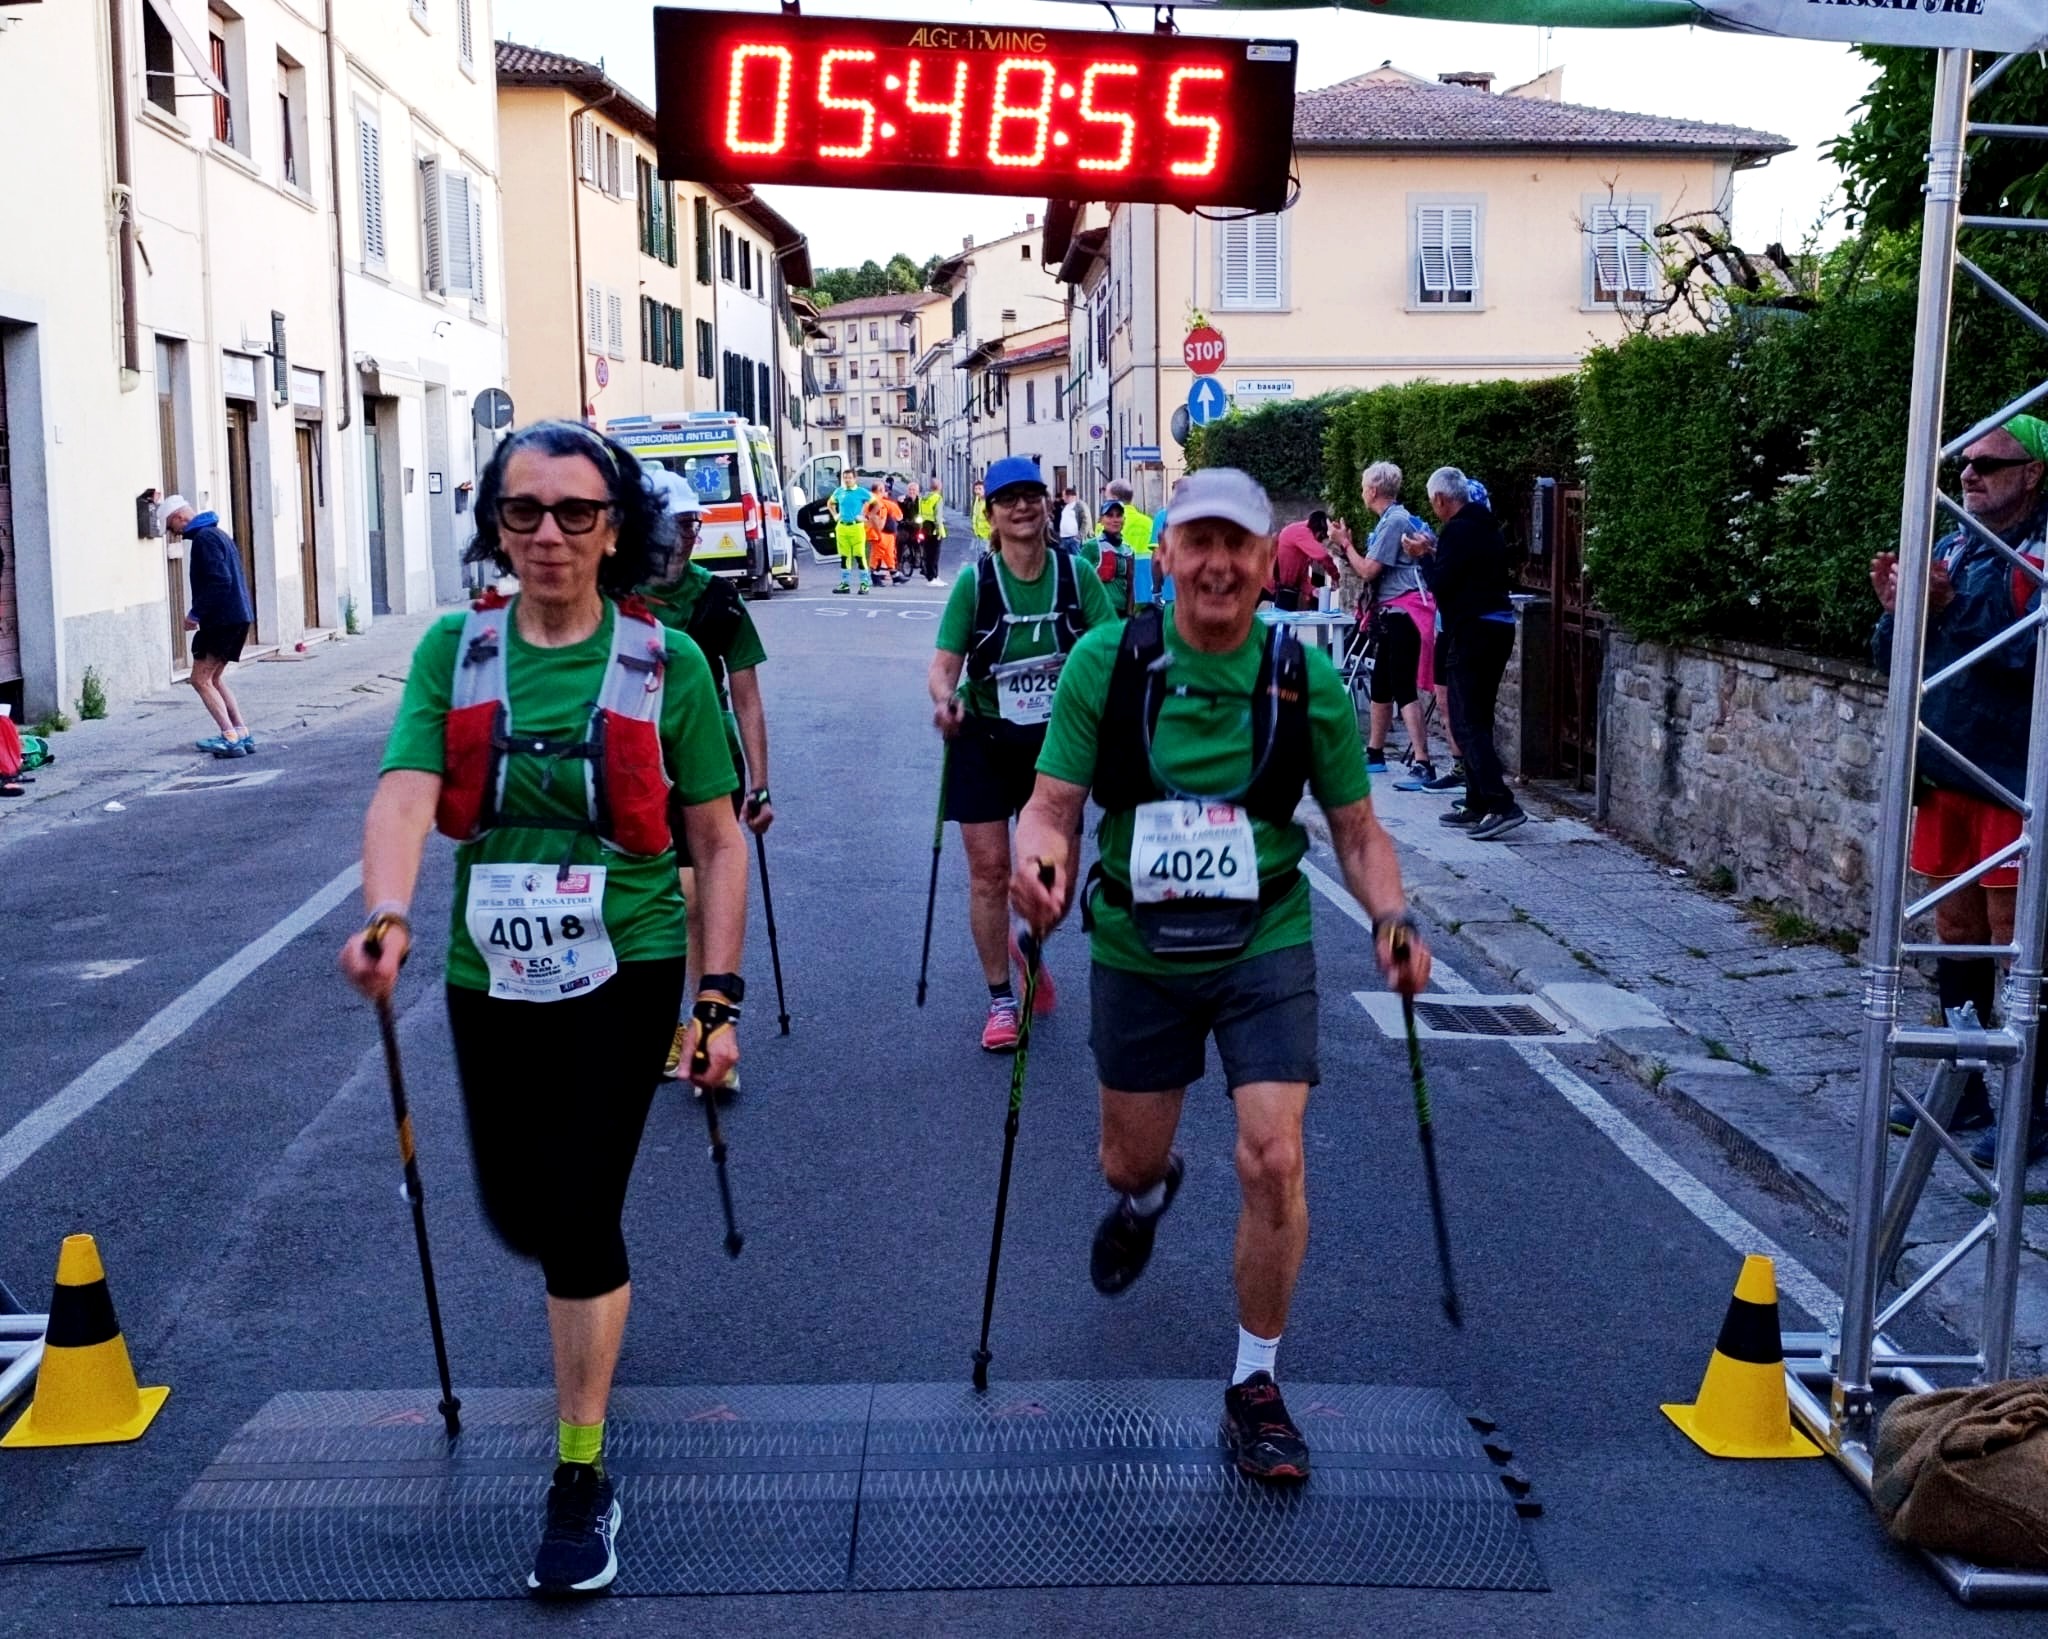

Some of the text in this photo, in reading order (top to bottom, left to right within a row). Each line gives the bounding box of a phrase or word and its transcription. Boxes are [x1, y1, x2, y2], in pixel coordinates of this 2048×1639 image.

[1185, 340, 1223, 362] STOP
[620, 430, 728, 445] MISERICORDIA ANTELLA
[814, 607, 939, 620] STO
[1008, 673, 1059, 694] 4028
[1149, 845, 1238, 883] 4026
[507, 898, 526, 906] DEL
[489, 914, 585, 952] 4018
